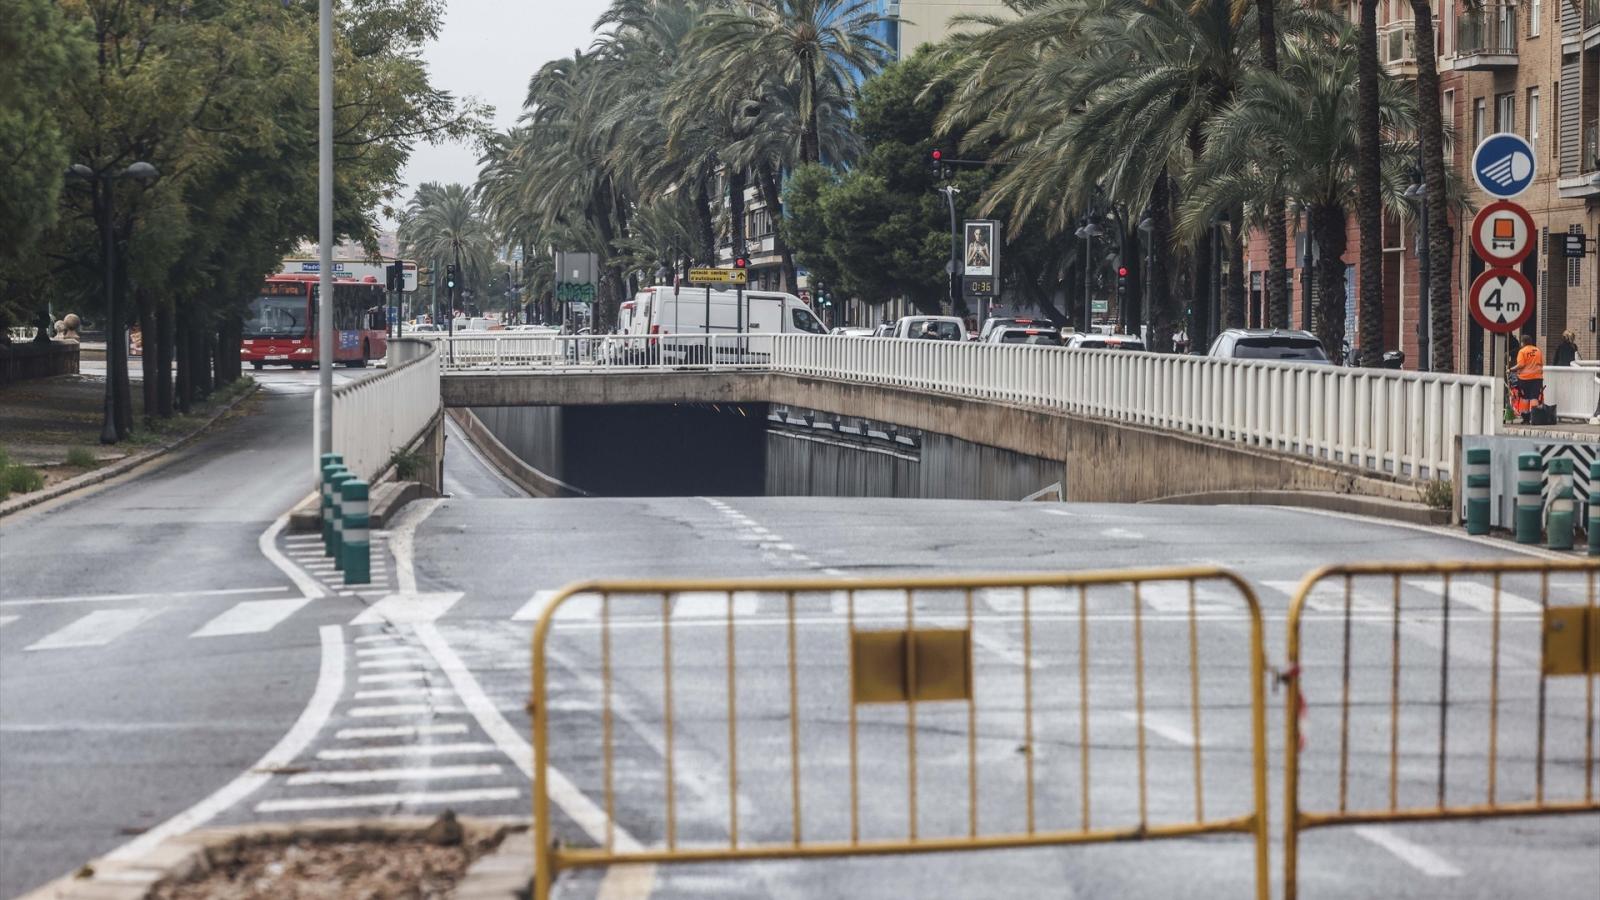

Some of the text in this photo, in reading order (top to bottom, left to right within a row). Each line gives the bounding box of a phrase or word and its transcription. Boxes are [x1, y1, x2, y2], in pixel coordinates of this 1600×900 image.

[972, 281, 991, 292] 0:36
[1484, 288, 1520, 312] 4 m
